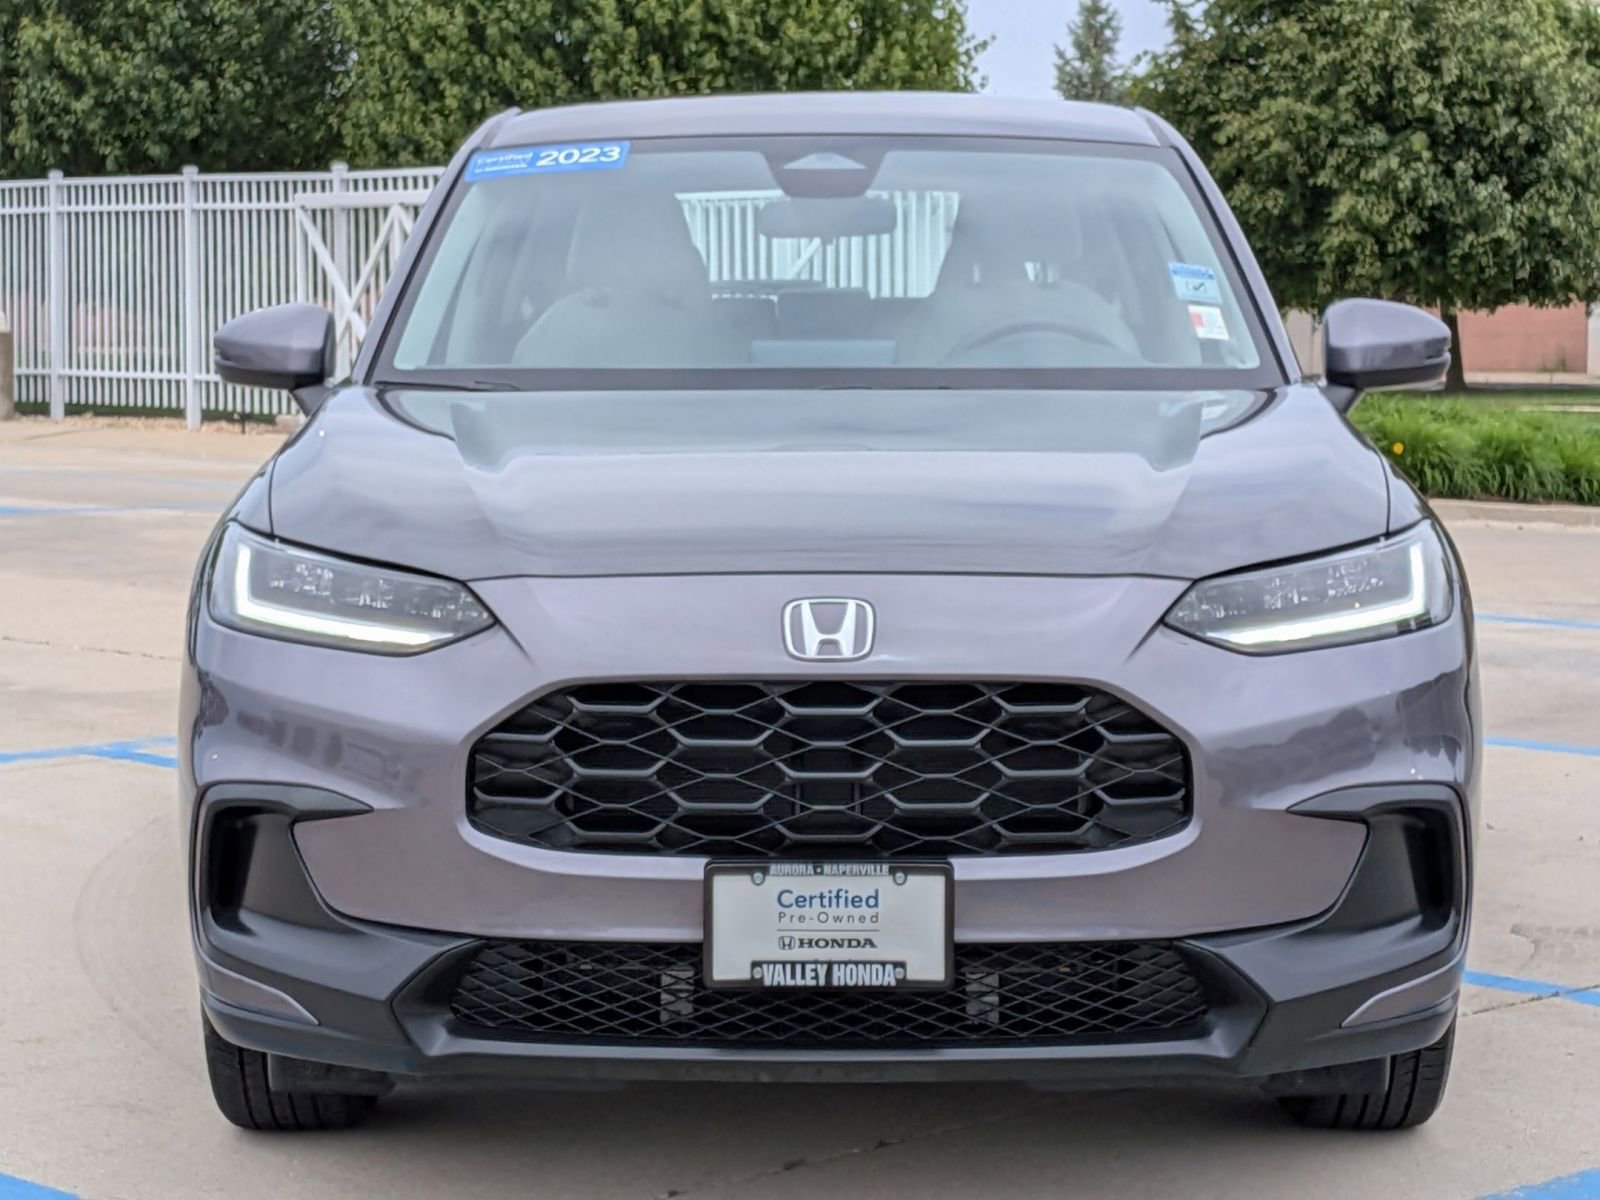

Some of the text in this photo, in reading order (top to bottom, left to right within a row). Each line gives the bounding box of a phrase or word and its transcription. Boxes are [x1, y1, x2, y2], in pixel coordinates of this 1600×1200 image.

[536, 146, 622, 167] 2023
[769, 863, 890, 876] AURORA NAPERVILLE
[776, 888, 880, 909] Certified
[778, 911, 880, 924] Pre-Owned
[798, 937, 878, 949] HONDA
[762, 962, 897, 986] VALLEY HONDA
